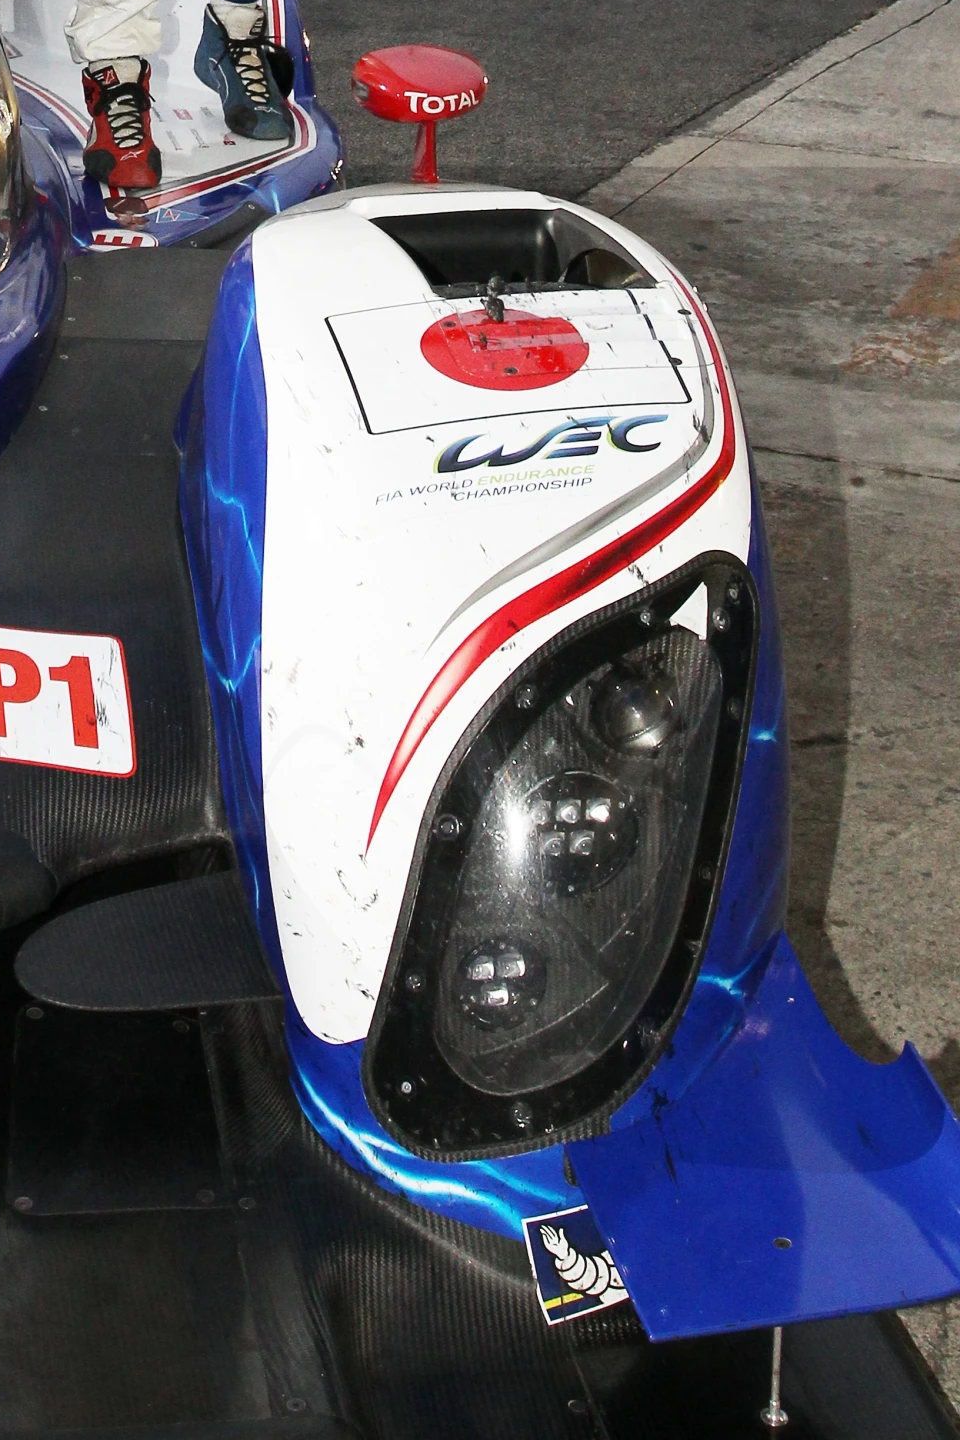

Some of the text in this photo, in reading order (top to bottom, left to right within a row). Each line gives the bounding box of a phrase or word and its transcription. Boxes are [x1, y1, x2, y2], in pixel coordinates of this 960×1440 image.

[403, 89, 480, 114] TOTAL
[433, 413, 669, 474] WEC
[375, 464, 596, 506] FIA WORLD ENDURANCE
[453, 477, 594, 502] CHAMPIONSHIP
